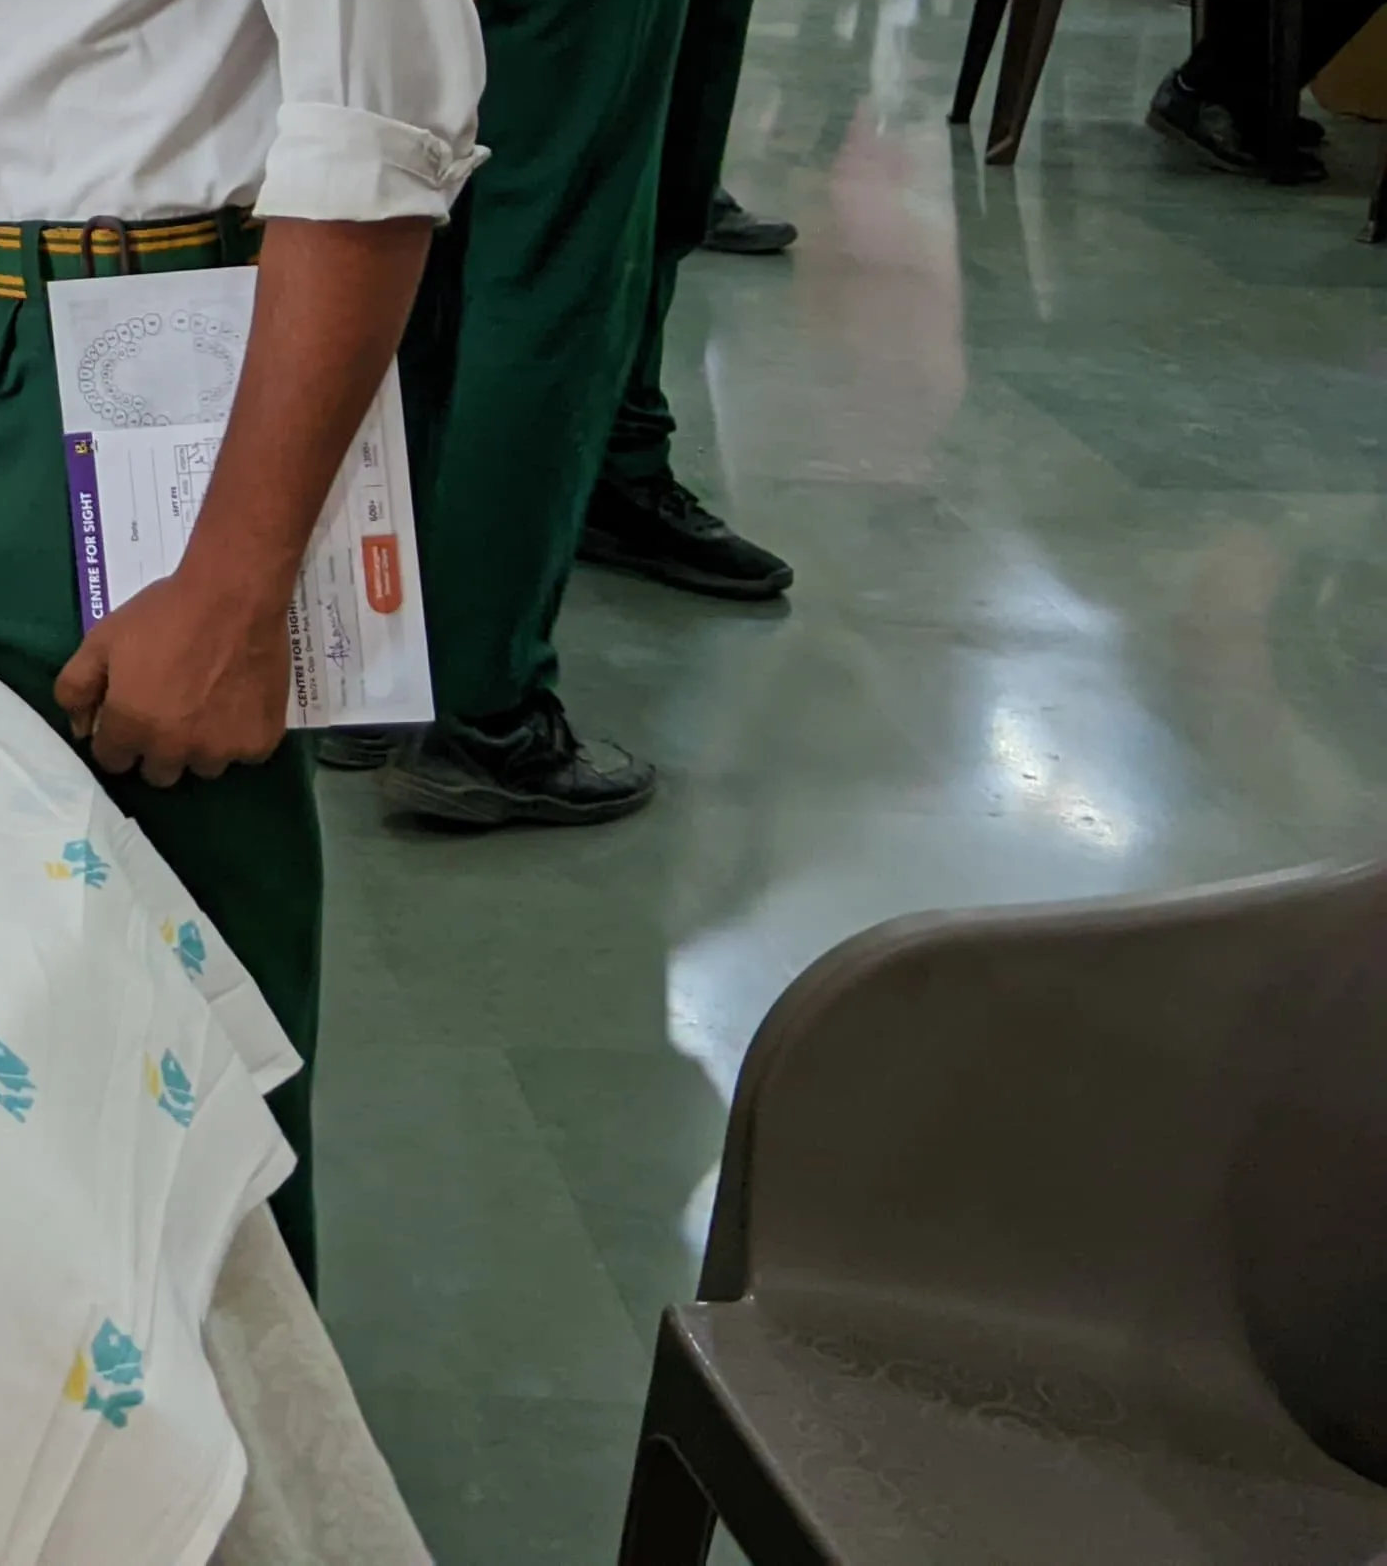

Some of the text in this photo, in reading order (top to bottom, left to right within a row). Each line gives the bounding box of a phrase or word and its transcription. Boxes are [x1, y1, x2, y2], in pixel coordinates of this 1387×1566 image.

[79, 492, 105, 620] CENTRE FOR SIGHT
[288, 600, 308, 709] CENTRE FOR SIGH
